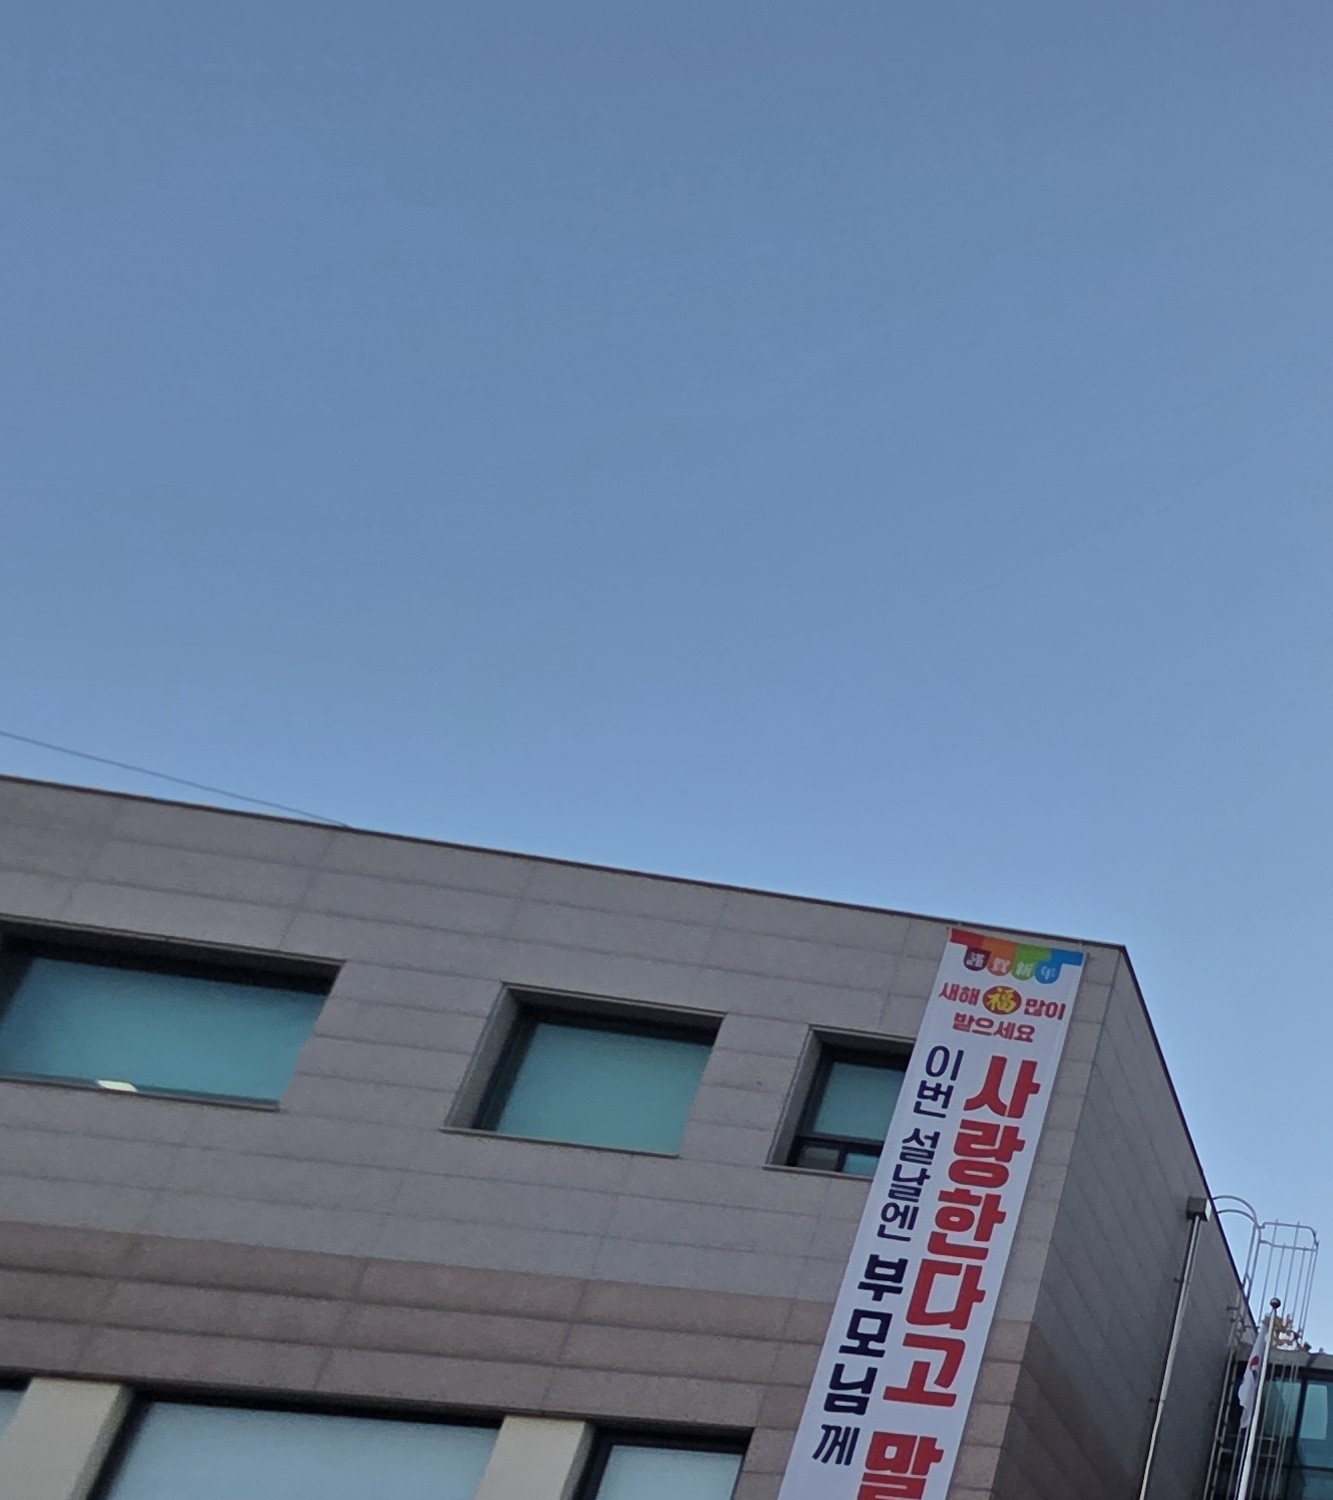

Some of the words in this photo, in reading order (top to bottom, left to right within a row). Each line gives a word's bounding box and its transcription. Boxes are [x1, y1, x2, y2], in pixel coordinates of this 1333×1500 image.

[938, 981, 981, 1006] 새해
[986, 986, 1018, 1013] 福
[1023, 997, 1067, 1021] 많이
[952, 1011, 1036, 1043] 받으세요
[914, 1045, 964, 1119] 이번
[877, 1127, 940, 1242] 설날엔
[883, 1054, 1042, 1408] 사랑한다고
[812, 1254, 909, 1467] 부모님께
